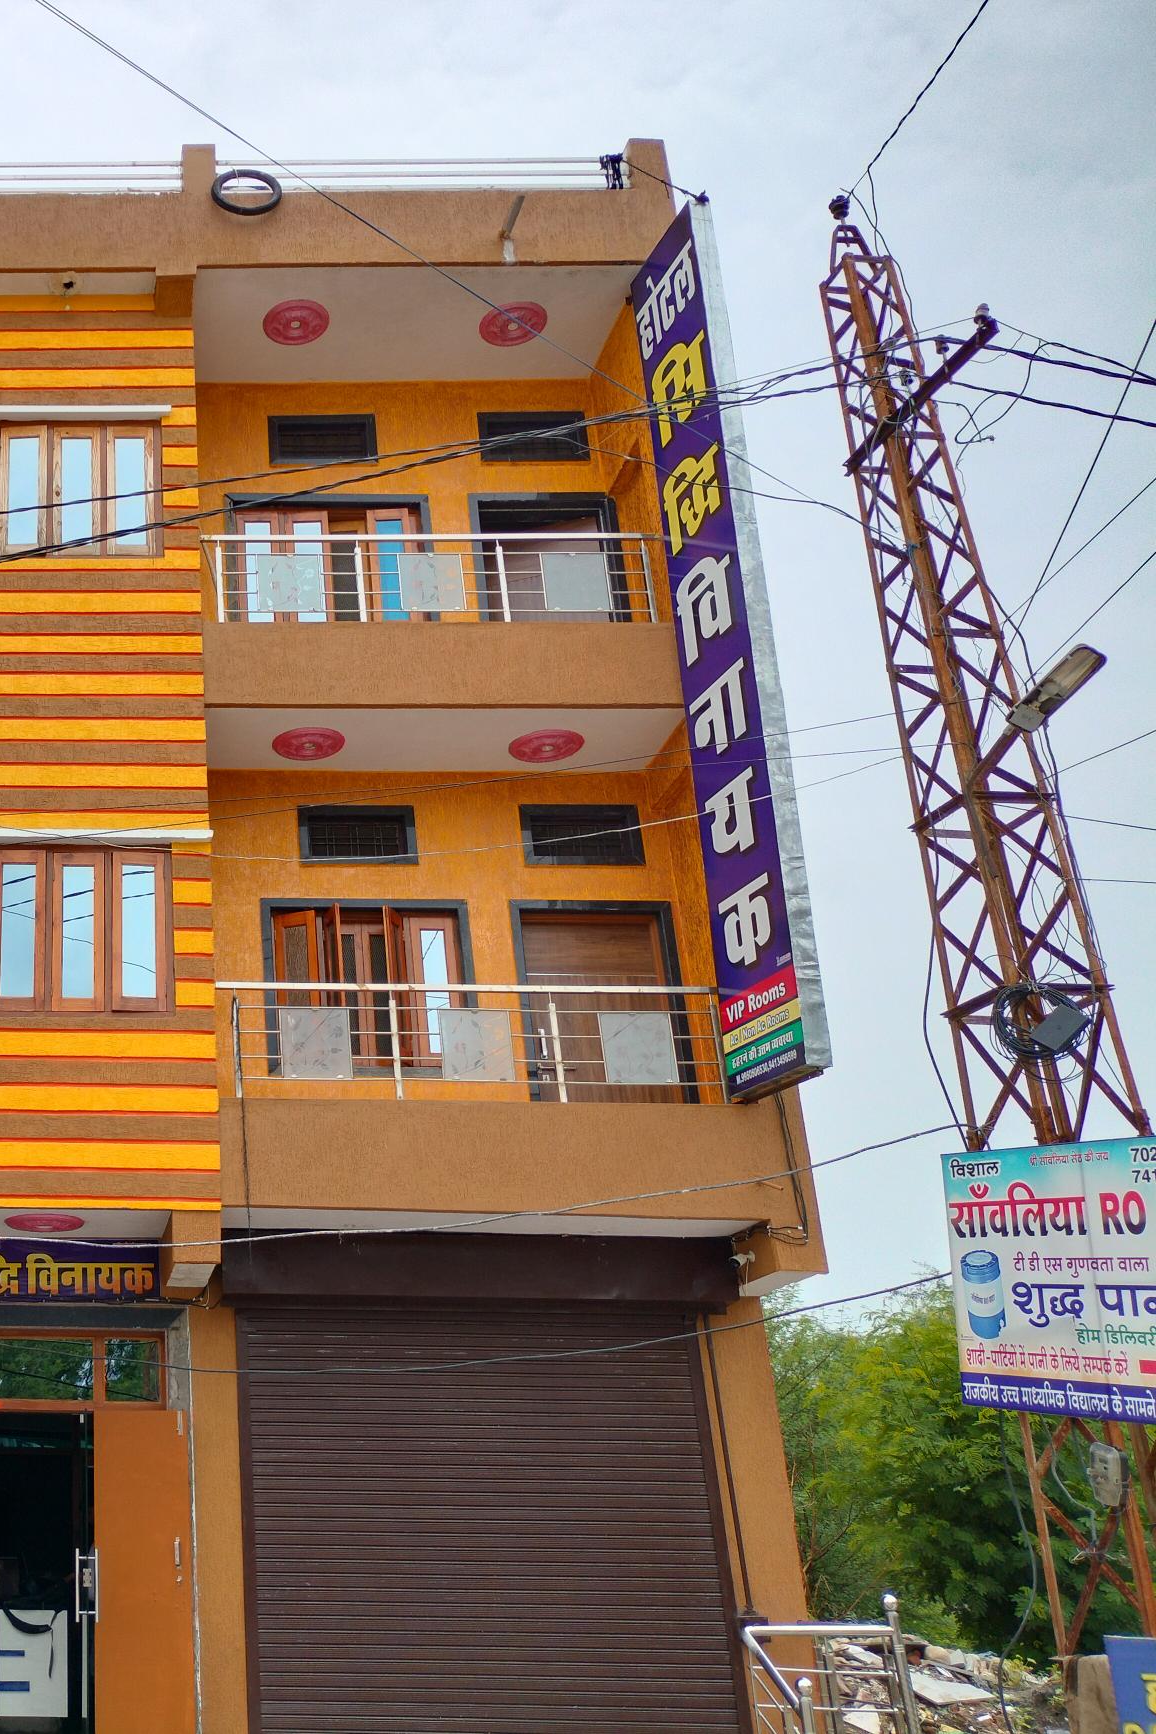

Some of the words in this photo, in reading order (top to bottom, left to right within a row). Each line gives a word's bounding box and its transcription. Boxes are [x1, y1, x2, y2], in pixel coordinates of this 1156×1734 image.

[636, 238, 696, 361] होटल
[726, 1000, 745, 1024] VIP
[748, 982, 786, 1013] Rooms
[767, 1009, 789, 1029] Rooms
[950, 1159, 999, 1178] विशाल
[1084, 1149, 1094, 1162] की
[1095, 1151, 1109, 1161] जय
[1099, 1190, 1147, 1236] RO
[26, 1253, 155, 1296] विनायक
[1013, 1251, 1025, 1272] टी
[1028, 1251, 1040, 1272] डी
[1043, 1257, 1063, 1275] एस
[1117, 1257, 1150, 1273] वाला
[1012, 1281, 1085, 1328] शुद्ध
[1075, 1322, 1101, 1345] होम
[1019, 1344, 1027, 1369] में
[1028, 1346, 1049, 1371] पानी
[1050, 1346, 1060, 1371] के
[1060, 1347, 1081, 1373] लिये
[1114, 1351, 1130, 1377] करें
[963, 1376, 999, 1402] राजकीय
[1000, 1385, 1020, 1405] उच्च
[1021, 1381, 1065, 1409] माध्यमिक
[1066, 1383, 1109, 1414] विद्यालय
[1111, 1386, 1123, 1415] के
[1124, 1390, 1156, 1419] सामने
